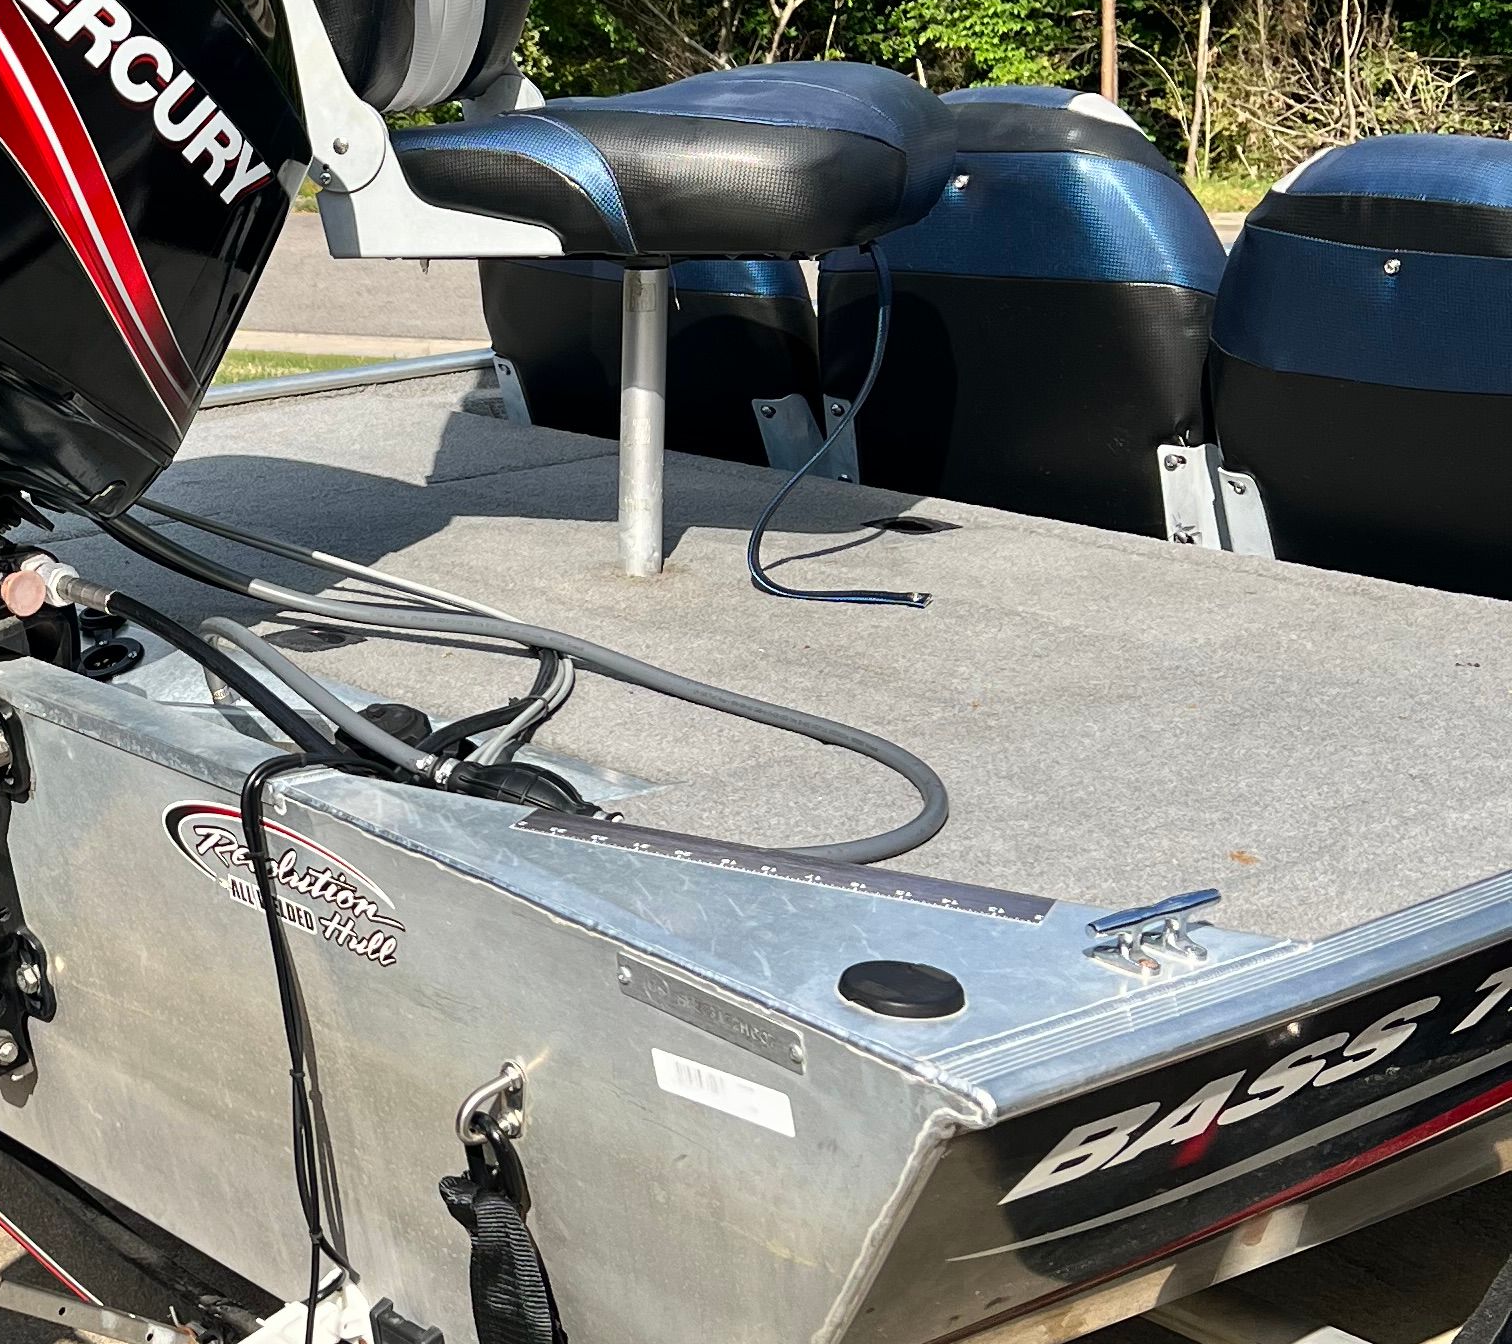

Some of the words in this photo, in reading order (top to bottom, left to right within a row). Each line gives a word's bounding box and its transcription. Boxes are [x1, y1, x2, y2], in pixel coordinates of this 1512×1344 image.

[193, 825, 405, 931] Reolution
[231, 879, 255, 906] ALL
[319, 911, 397, 966] Hull
[998, 995, 1442, 1205] BASS
